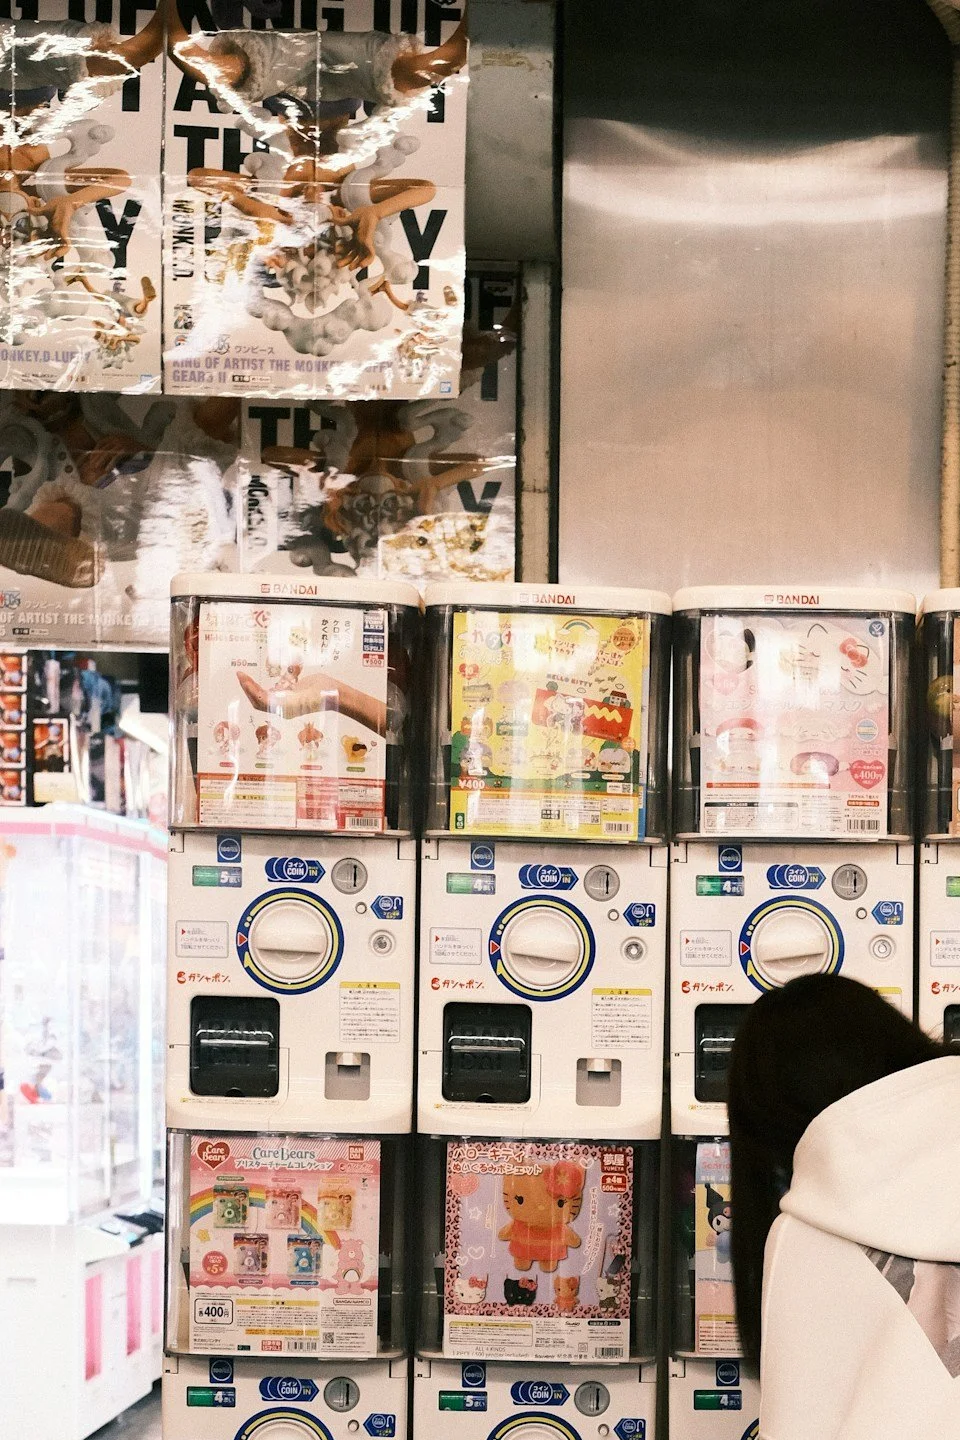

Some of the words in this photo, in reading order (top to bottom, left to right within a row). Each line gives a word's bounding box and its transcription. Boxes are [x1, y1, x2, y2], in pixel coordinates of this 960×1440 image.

[234, 346, 275, 355] ワンピース
[204, 358, 220, 369] OF
[223, 358, 264, 370] ARTIST
[269, 359, 290, 371] THE
[273, 584, 318, 595] BANDAI
[532, 593, 576, 605] BANDAI
[776, 594, 820, 605] BANDAI
[18, 612, 59, 625] ARTIST
[63, 613, 86, 625] THE
[458, 778, 486, 790] ¥400
[286, 866, 305, 876] COIN
[540, 874, 558, 883] COIN
[788, 874, 806, 883] COIN
[206, 1146, 225, 1155] Care
[253, 1147, 280, 1160] Care
[281, 1148, 316, 1161] Bears
[453, 1147, 526, 1162] ハローキティ
[203, 1153, 226, 1163] Bears
[281, 1386, 299, 1395] COIN
[532, 1390, 550, 1399] COIN
